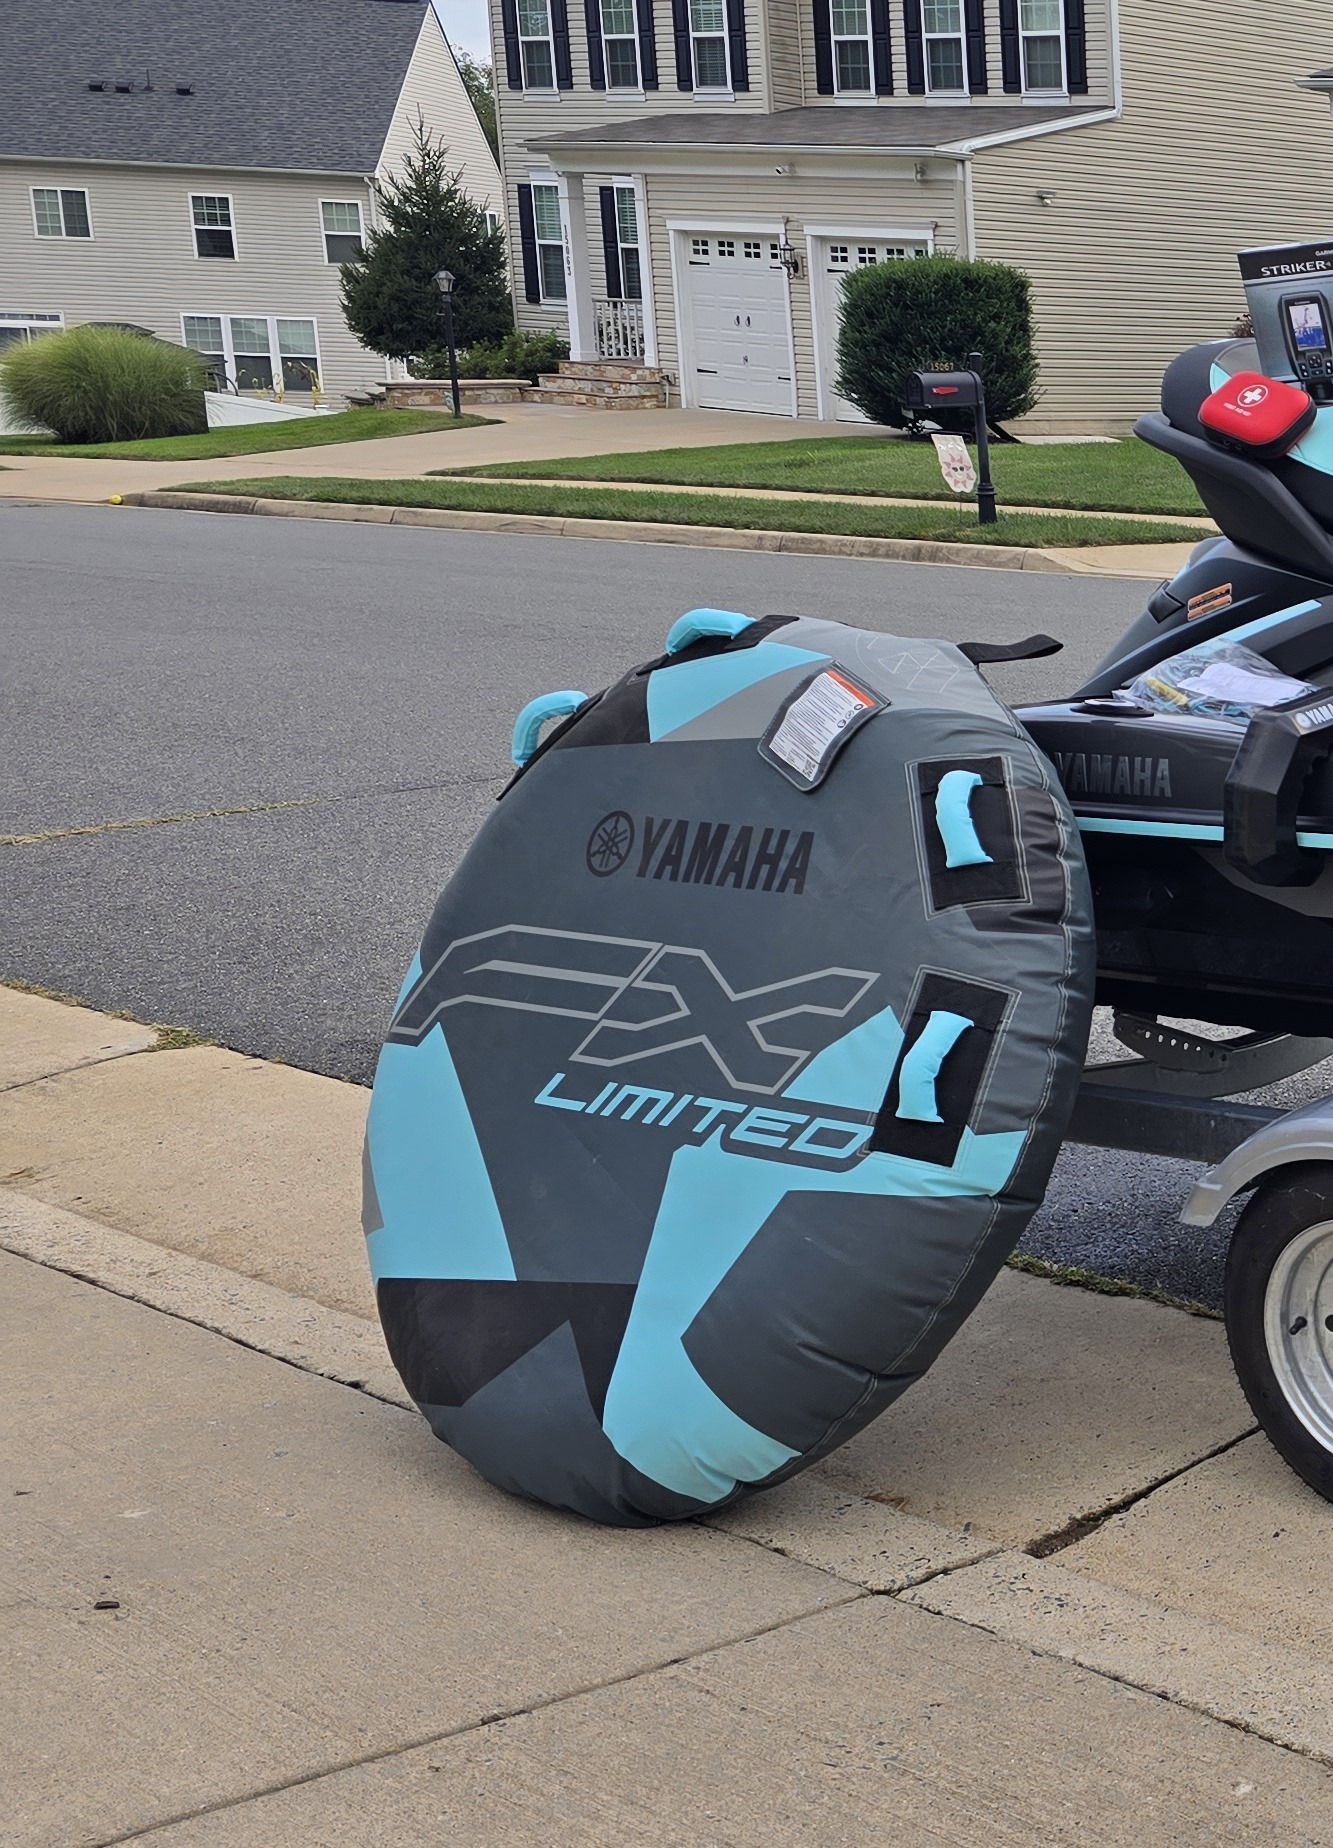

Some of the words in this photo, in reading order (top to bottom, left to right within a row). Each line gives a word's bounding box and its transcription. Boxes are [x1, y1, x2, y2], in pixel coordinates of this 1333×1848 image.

[563, 224, 572, 277] 15063
[1260, 260, 1326, 277] STRIKER
[1053, 751, 1172, 798] YAMAHA
[636, 816, 815, 895] YAMAHA
[389, 924, 881, 1095] FX
[533, 1072, 875, 1159] LIMITED
